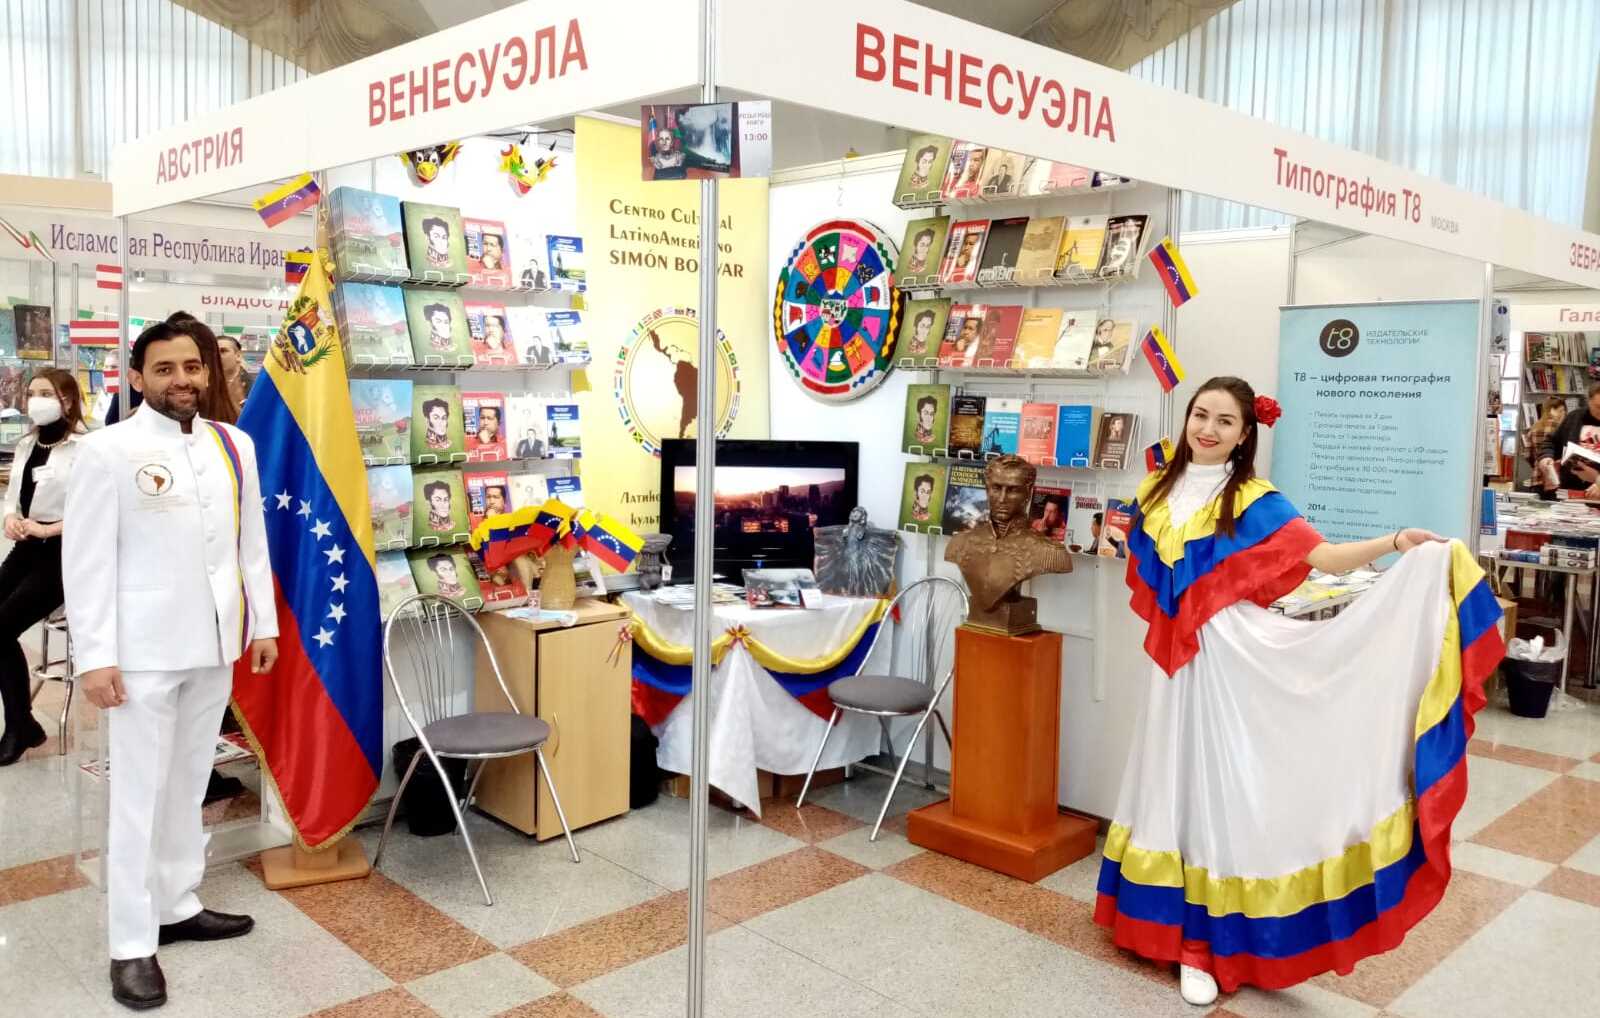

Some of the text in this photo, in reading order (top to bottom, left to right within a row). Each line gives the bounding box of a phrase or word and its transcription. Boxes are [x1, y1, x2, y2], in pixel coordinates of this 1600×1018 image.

[368, 18, 588, 127] ВЕНЕСУЭЛА
[856, 22, 1116, 143] ВЕНЕСУЭЛА
[744, 133, 768, 141] 13:00
[157, 127, 243, 184] АВСТРИЯ
[1273, 147, 1460, 234] Типография Т8 МОСКВА
[671, 207, 733, 230] Culal
[50, 223, 147, 257] Исламсая
[153, 232, 245, 265] Республика
[609, 249, 744, 278] SIMÓN BOAR
[1366, 329, 1429, 337] ИЗДАТЕЛЬСКИЕ
[1321, 373, 1377, 385] цифровая
[1381, 373, 1451, 385] типография
[1316, 390, 1422, 399] нового поколения
[1307, 503, 1326, 511] 2014
